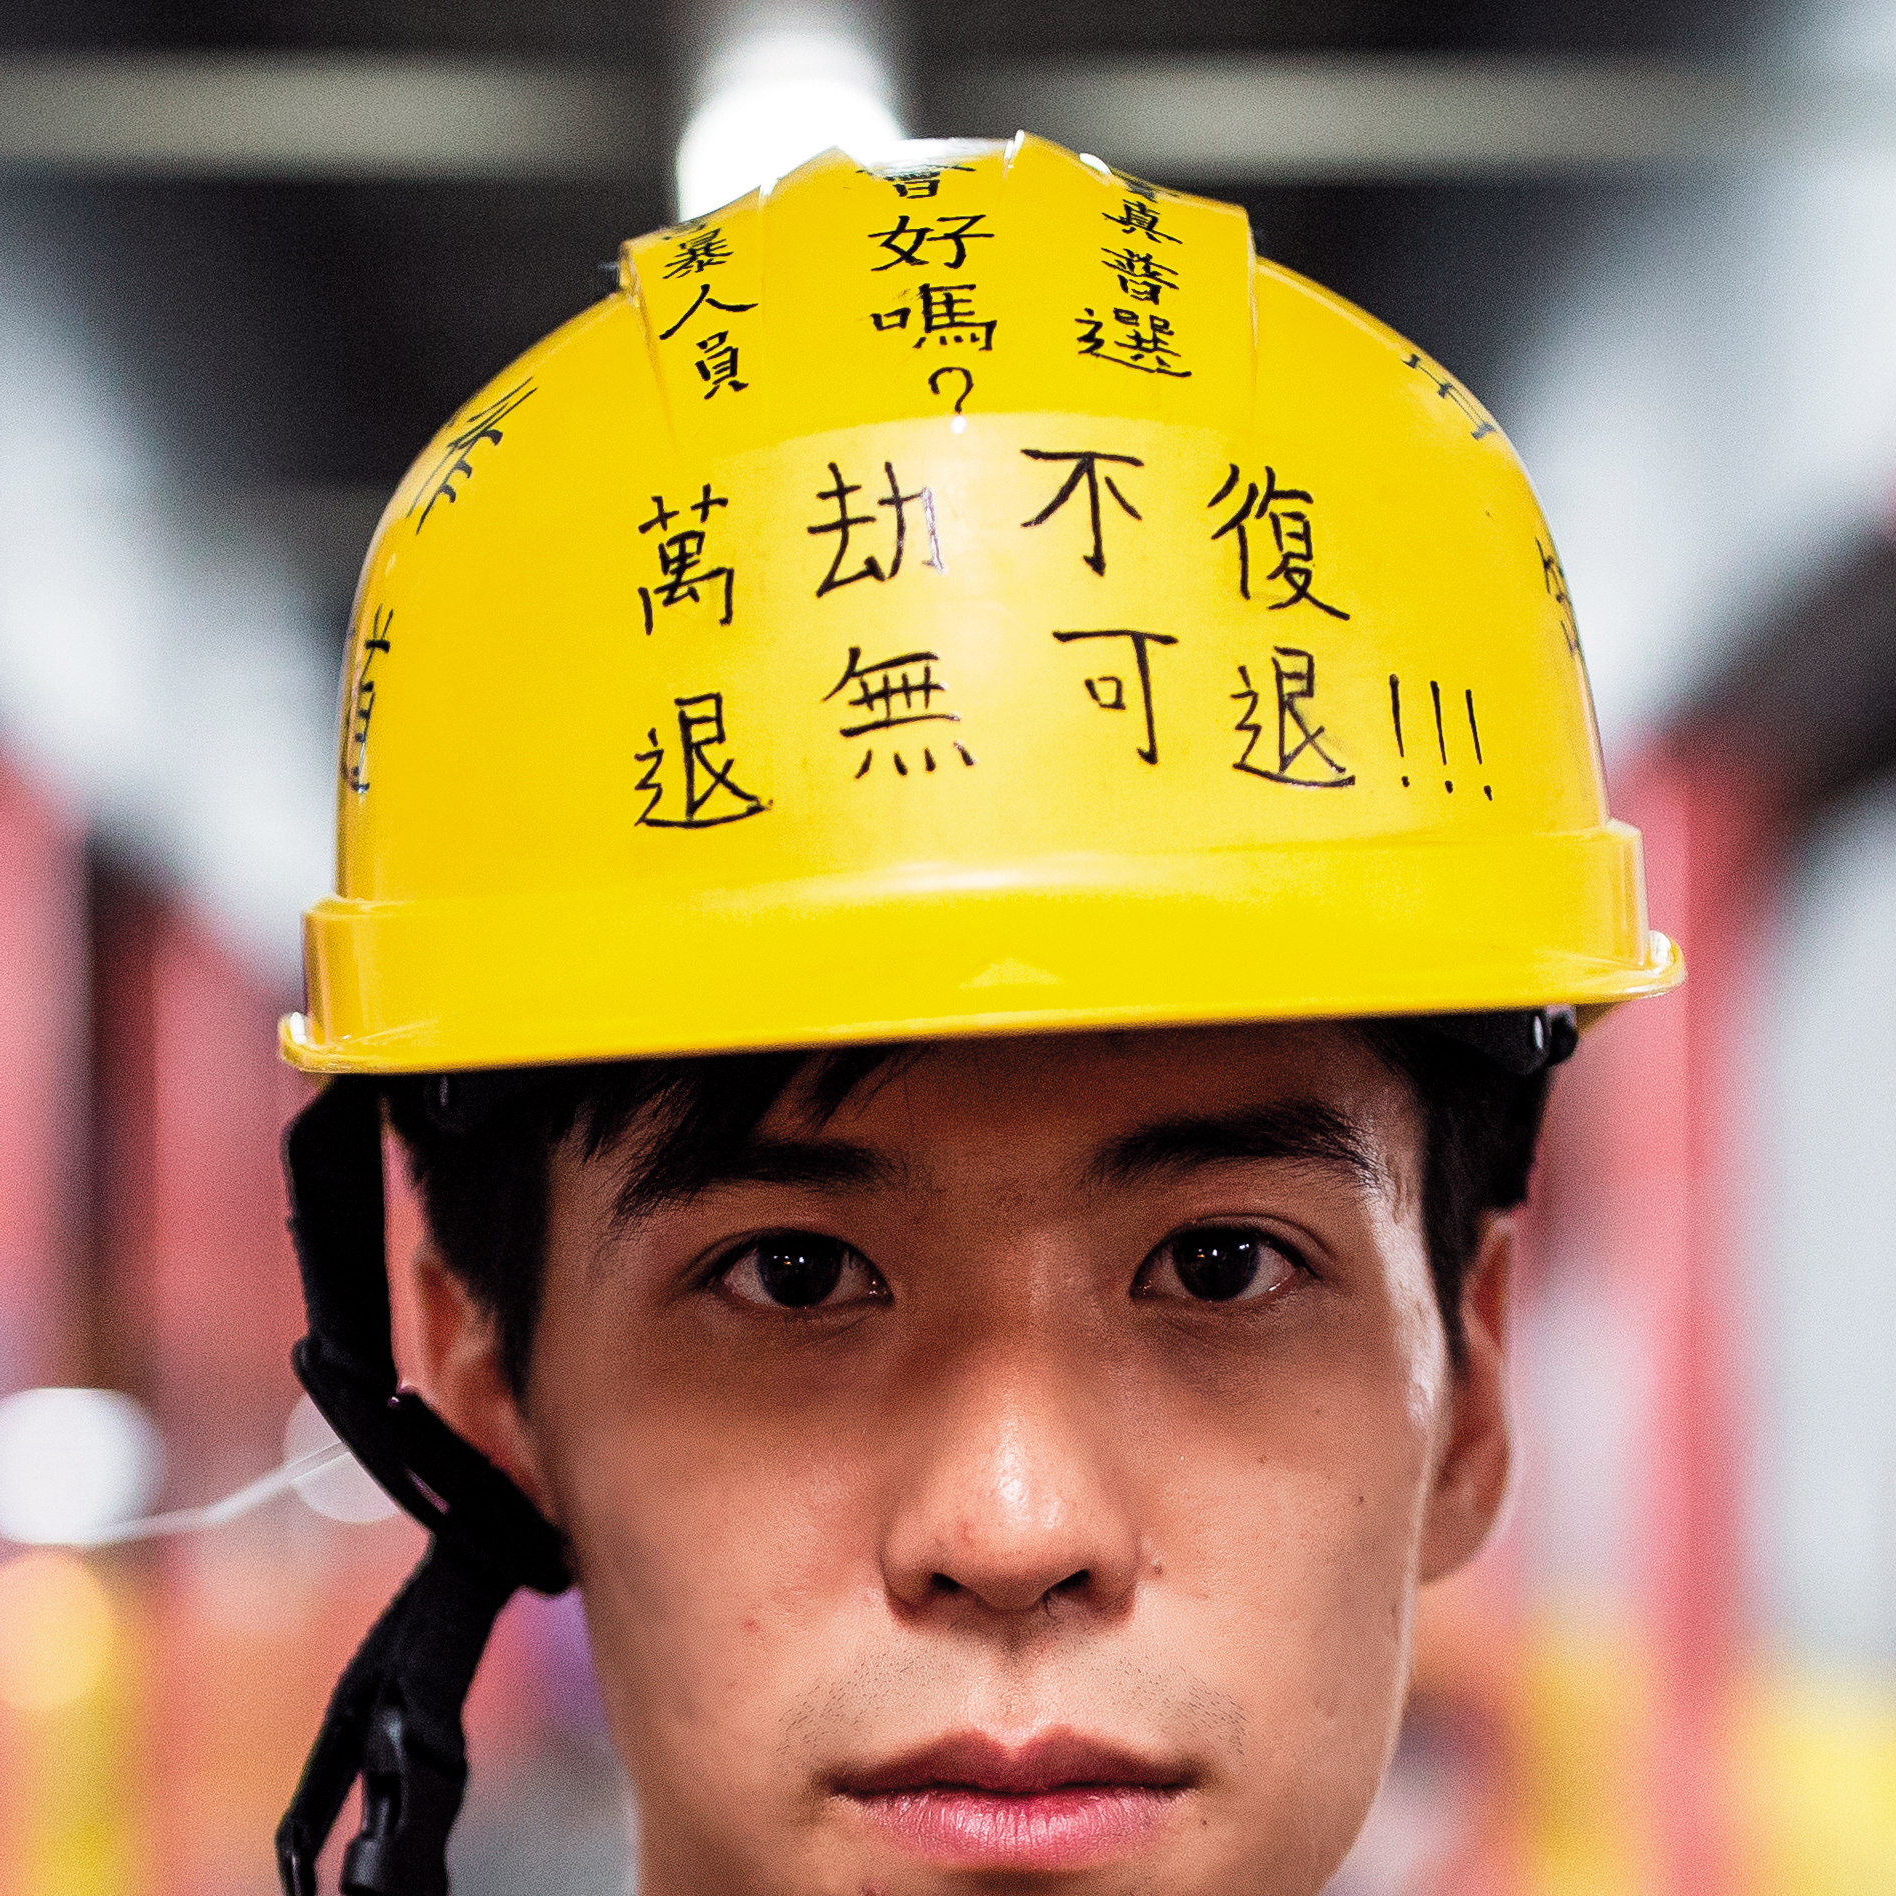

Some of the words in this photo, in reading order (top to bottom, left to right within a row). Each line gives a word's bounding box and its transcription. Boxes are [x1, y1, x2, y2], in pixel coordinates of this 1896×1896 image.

[658, 223, 759, 400] 暴人員
[637, 448, 1351, 636] 萬劫不復
[634, 629, 1493, 828] 退無可退!!!
